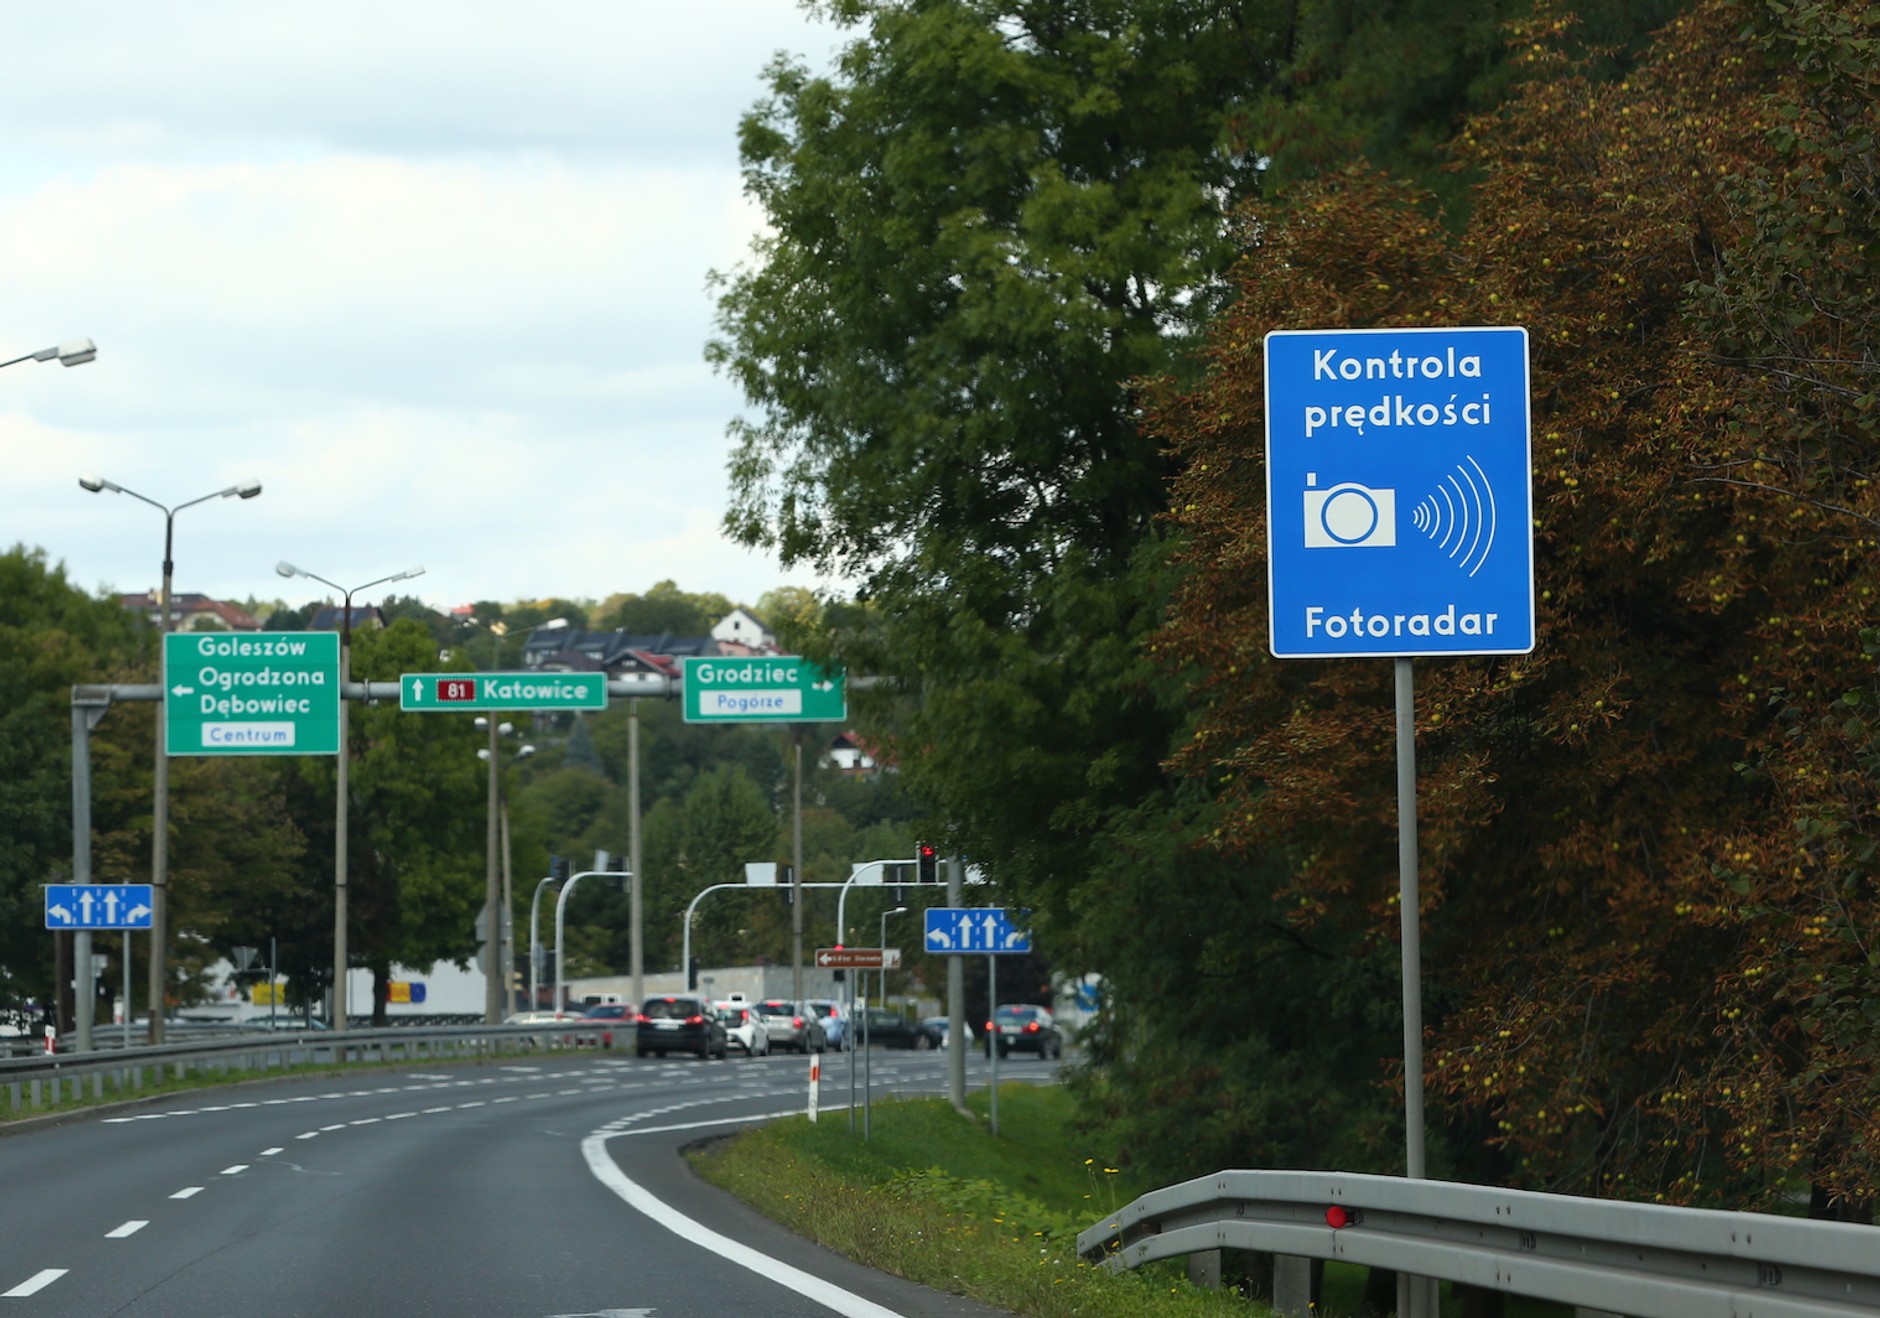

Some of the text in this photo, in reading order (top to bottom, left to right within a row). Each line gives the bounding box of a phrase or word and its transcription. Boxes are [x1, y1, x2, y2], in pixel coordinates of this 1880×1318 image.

[1314, 347, 1482, 380] Kontrola
[1305, 393, 1491, 438] prędkości
[1306, 604, 1498, 638] Fotoradar
[197, 636, 306, 656] Goleszów
[198, 666, 325, 691] Ogrodzona
[696, 662, 798, 683] Grodziec
[447, 679, 589, 699] 81 Katowice
[200, 694, 311, 719] Dębowiec
[717, 693, 784, 711] Pogórze
[210, 727, 287, 742] Centrum
